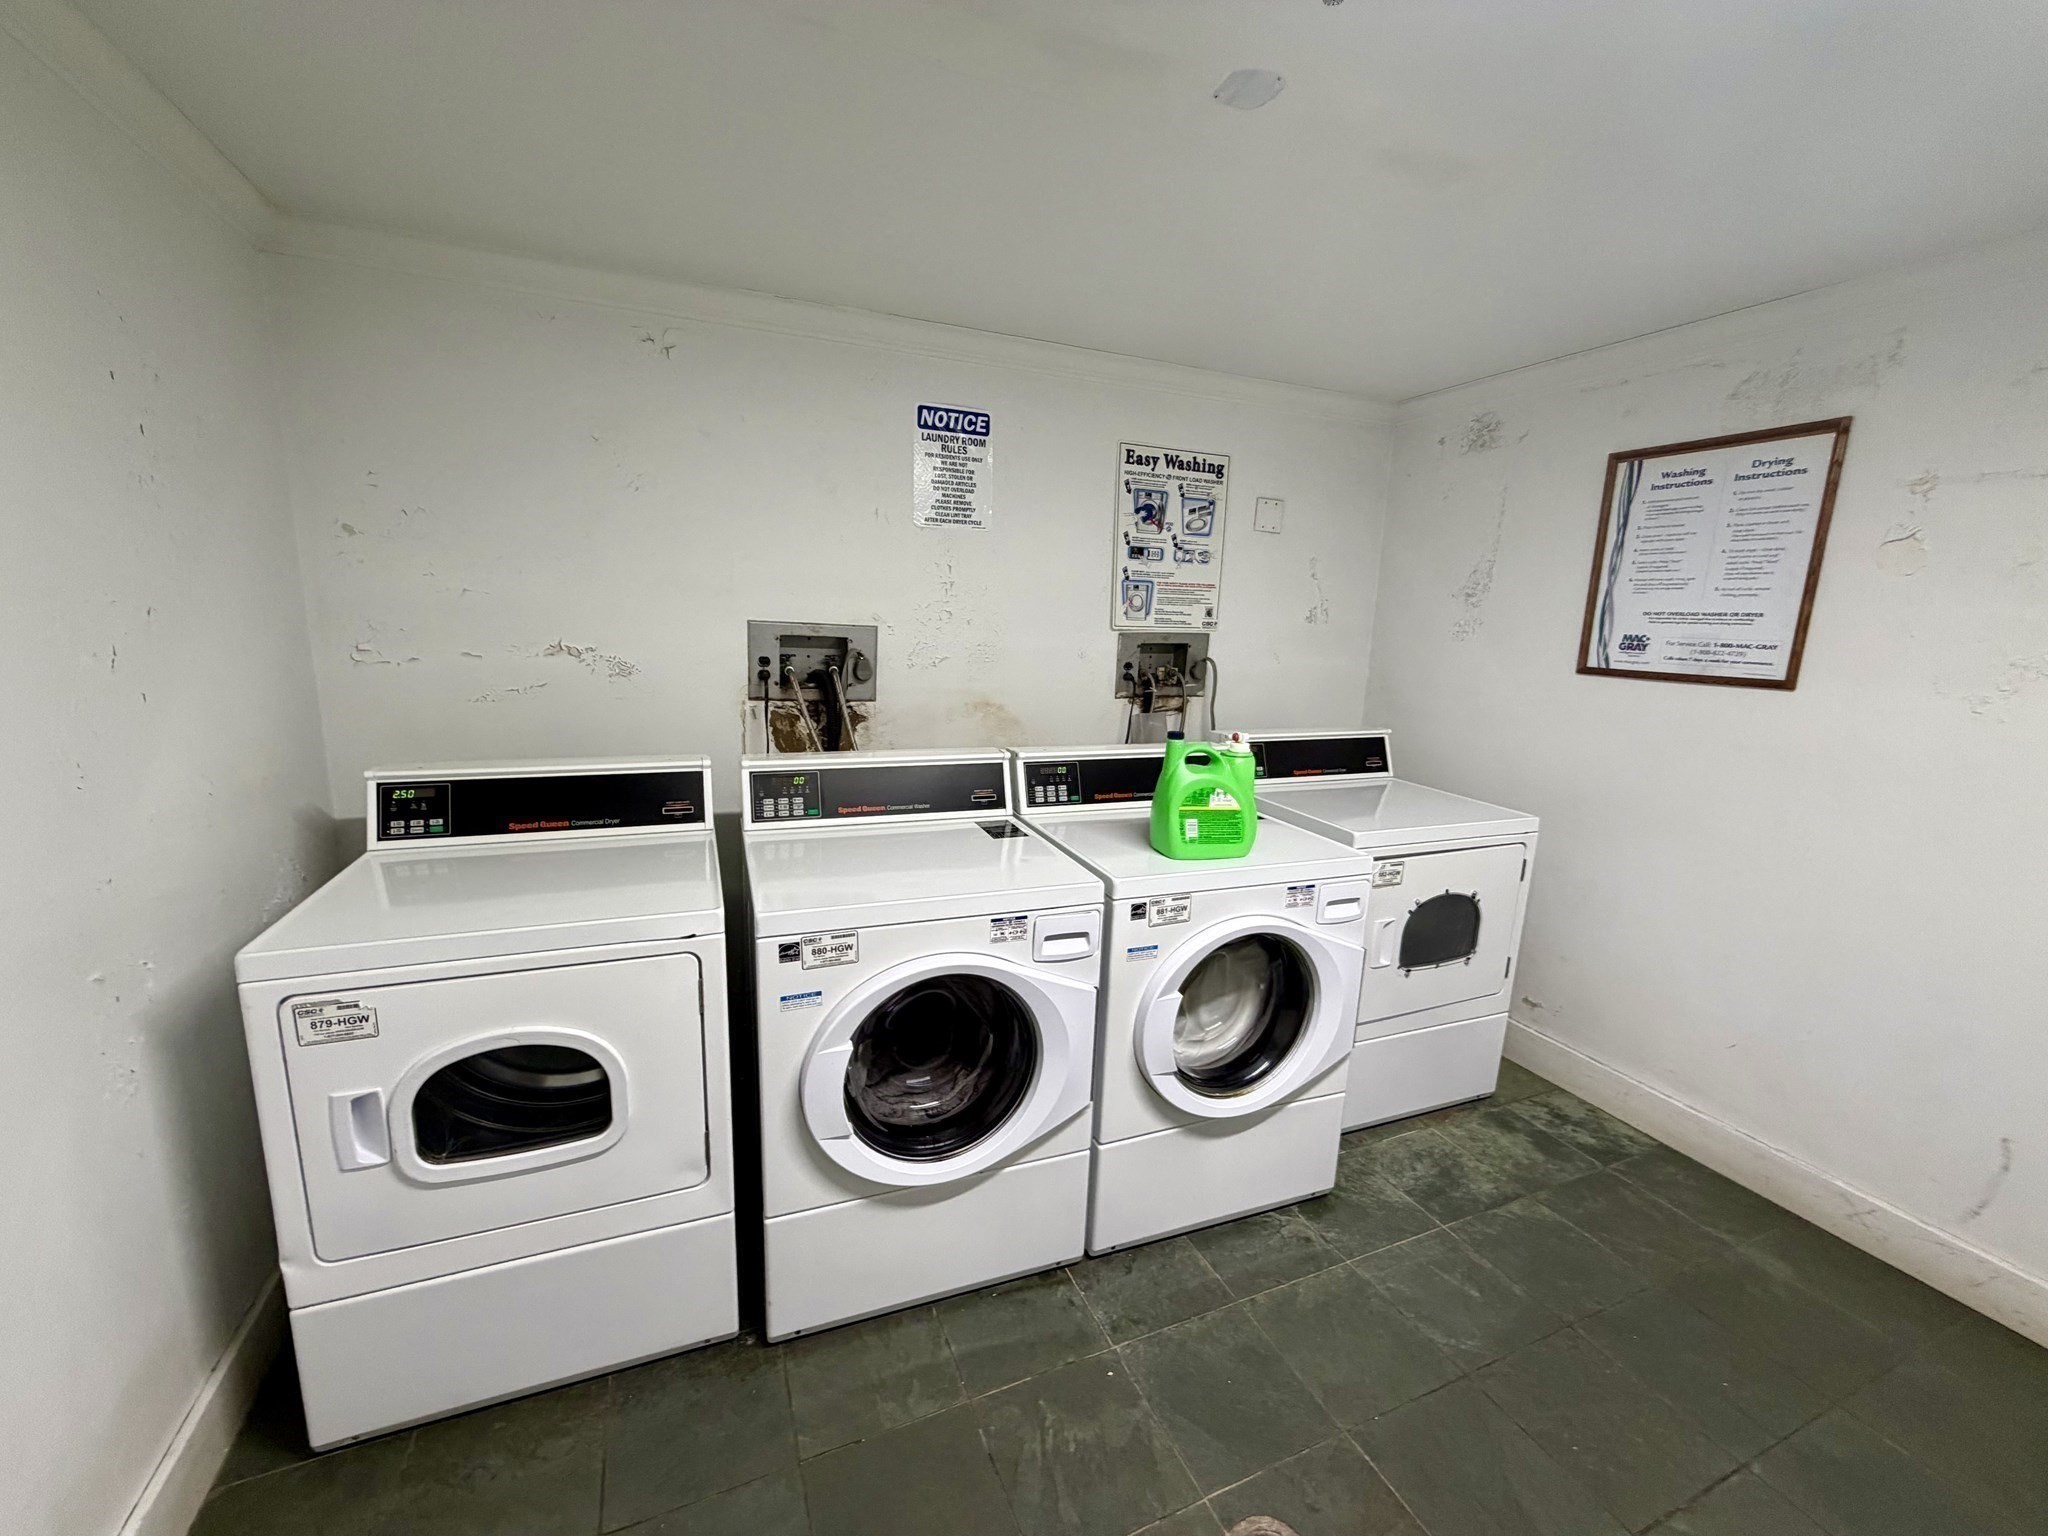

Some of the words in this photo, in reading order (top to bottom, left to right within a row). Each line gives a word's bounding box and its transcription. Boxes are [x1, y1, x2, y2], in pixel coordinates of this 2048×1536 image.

[920, 409, 988, 432] NOTICE
[922, 432, 960, 444] LAUNDRY
[962, 437, 986, 447] ROOM
[941, 444, 968, 455] RULES
[1124, 449, 1160, 472] Easy
[1163, 454, 1225, 479] Washing
[1752, 457, 1794, 469] Drying
[933, 466, 964, 474] RESPONSIBLE
[1124, 470, 1166, 479] HIGH-EFFICIENCY
[1661, 468, 1707, 479] Washing
[1734, 468, 1808, 481] Instructions
[1650, 479, 1714, 491] Instructions
[1619, 642, 1650, 651] GRAY
[508, 822, 539, 830] Speed
[1156, 905, 1188, 915] 881-HGW
[811, 944, 854, 955] 880-HGW
[310, 1015, 370, 1030] 879-HGW
